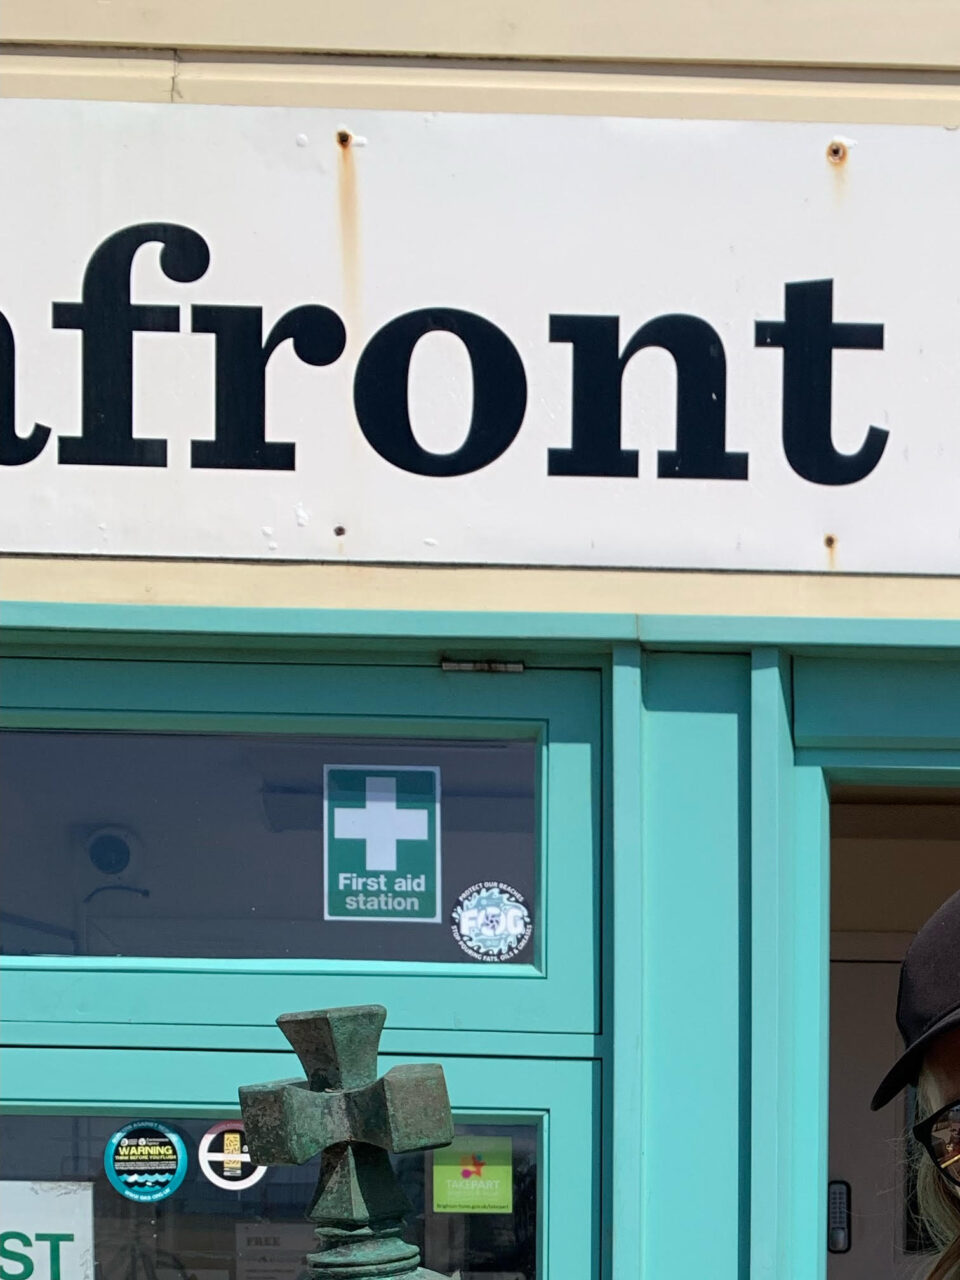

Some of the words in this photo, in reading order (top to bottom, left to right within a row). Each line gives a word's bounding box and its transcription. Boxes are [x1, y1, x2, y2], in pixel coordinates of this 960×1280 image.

[338, 873, 388, 891] First
[394, 875, 426, 892] aid
[459, 882, 483, 902] PROTECT
[499, 882, 525, 902] BEACHES
[345, 893, 419, 911] station
[451, 925, 461, 941] STOP
[458, 940, 482, 961] POURING
[500, 951, 514, 961] OILS
[517, 924, 532, 951] GREASES
[118, 1145, 173, 1155] WARNING
[246, 1236, 281, 1246] FREE
